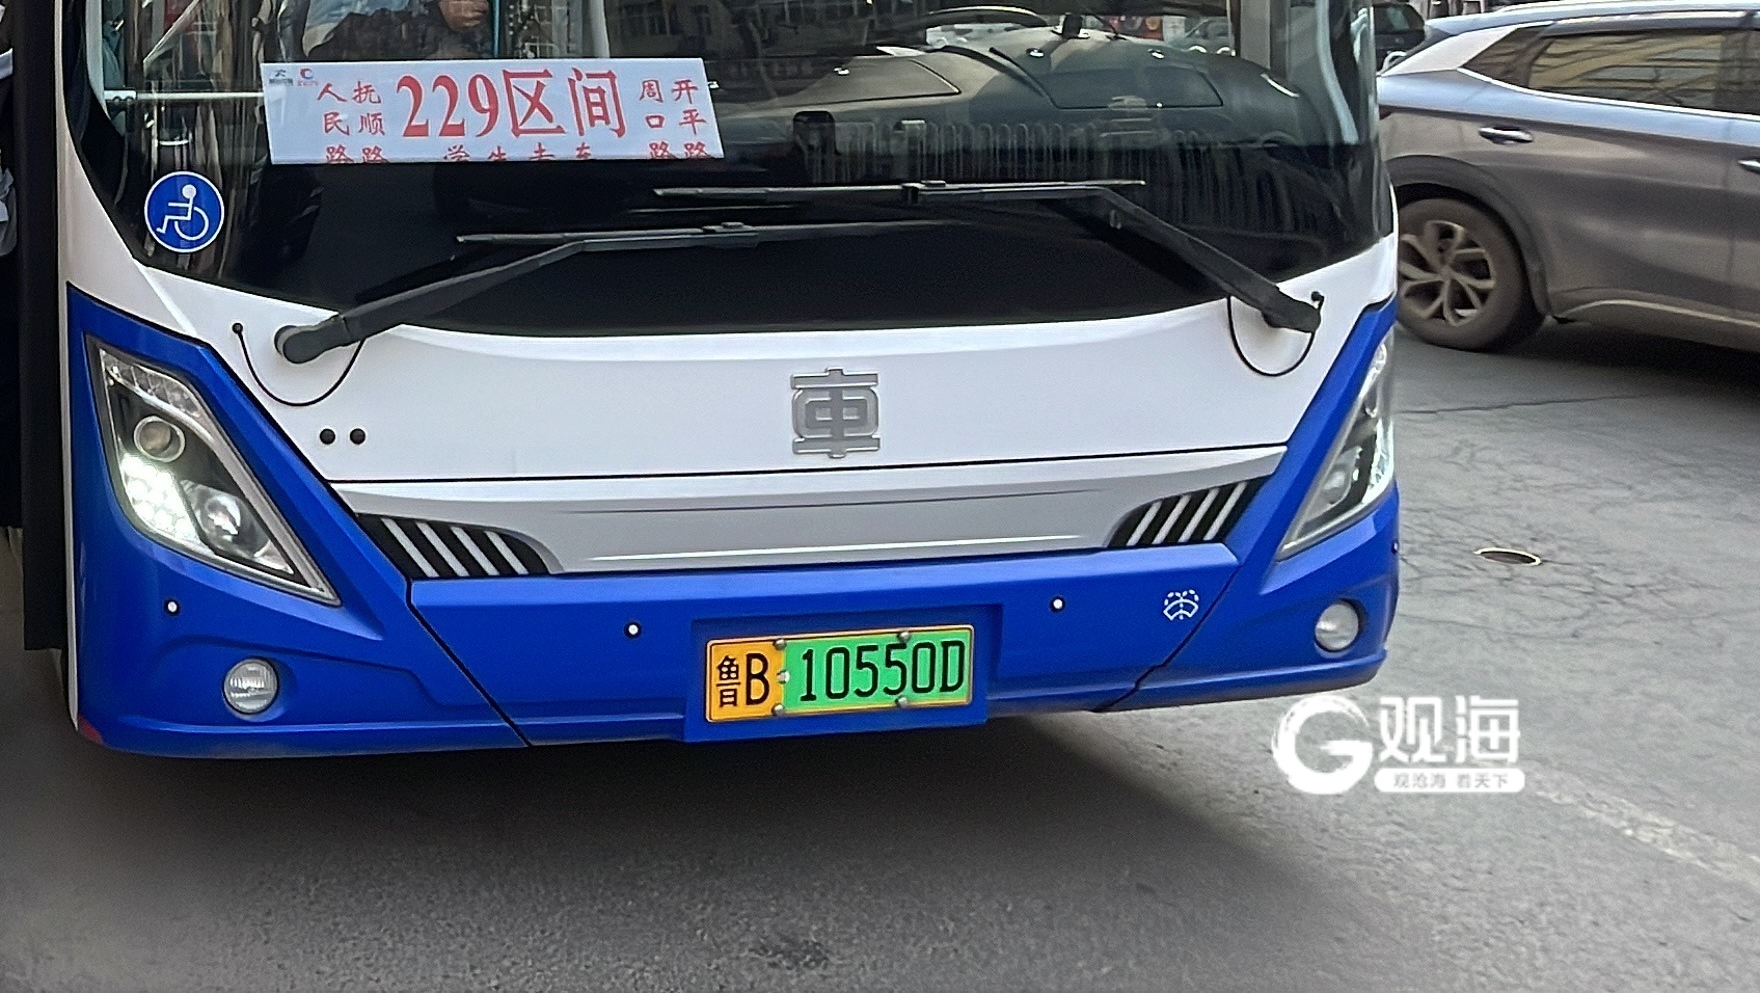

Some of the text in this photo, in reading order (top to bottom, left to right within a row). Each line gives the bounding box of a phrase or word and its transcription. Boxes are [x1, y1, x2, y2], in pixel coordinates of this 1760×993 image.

[396, 67, 626, 138] 229区间
[716, 639, 966, 708] 鲁B 10550D
